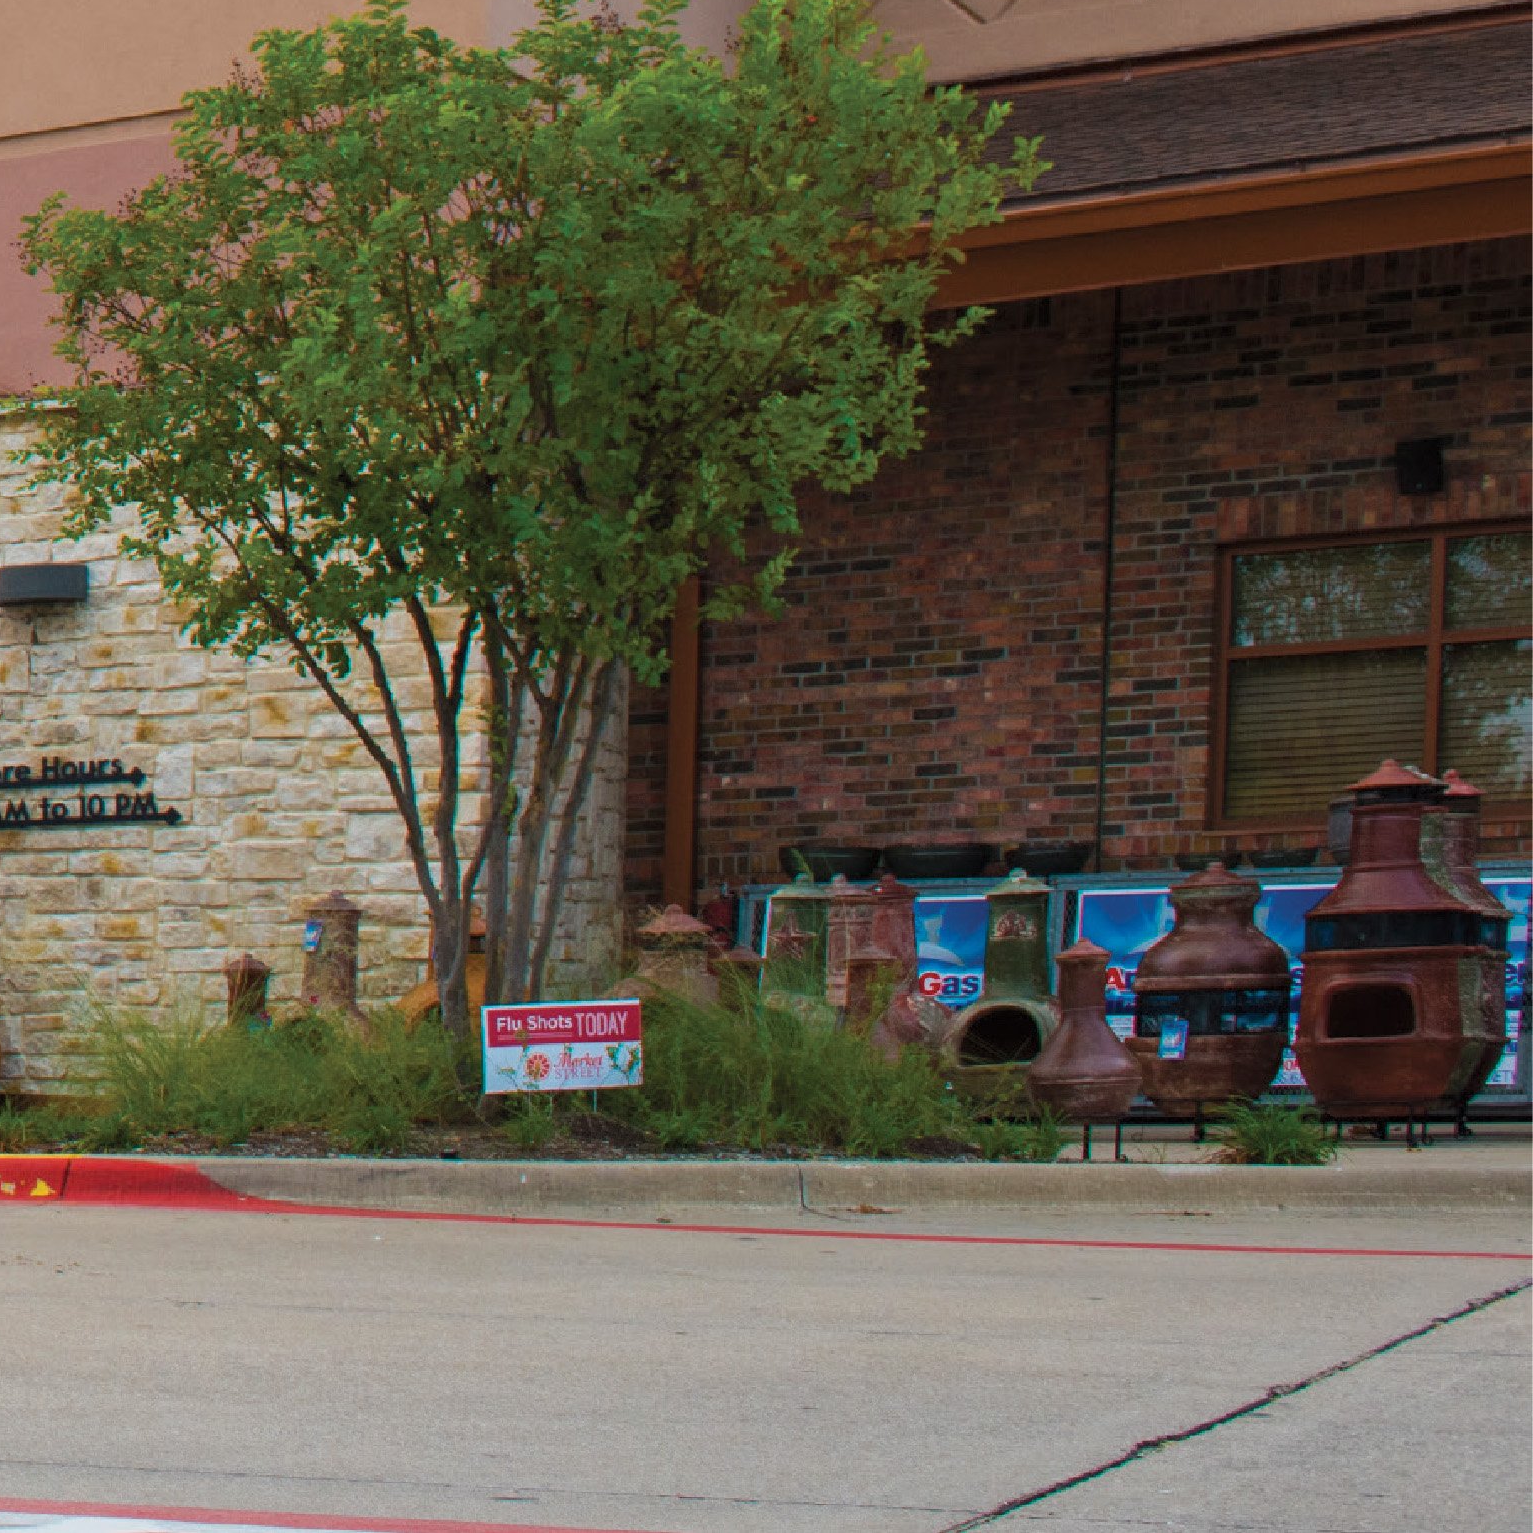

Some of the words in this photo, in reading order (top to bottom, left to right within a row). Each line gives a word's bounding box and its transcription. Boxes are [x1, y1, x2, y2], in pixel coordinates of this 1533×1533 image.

[41, 756, 123, 780] Hours
[39, 797, 68, 821] to
[79, 793, 105, 818] 10
[115, 791, 158, 815] PM
[496, 1017, 522, 1032] Flu
[526, 1015, 573, 1030] Shots
[574, 1010, 629, 1037] TODAY
[557, 1052, 603, 1066] Market
[554, 1066, 603, 1080] STREET
